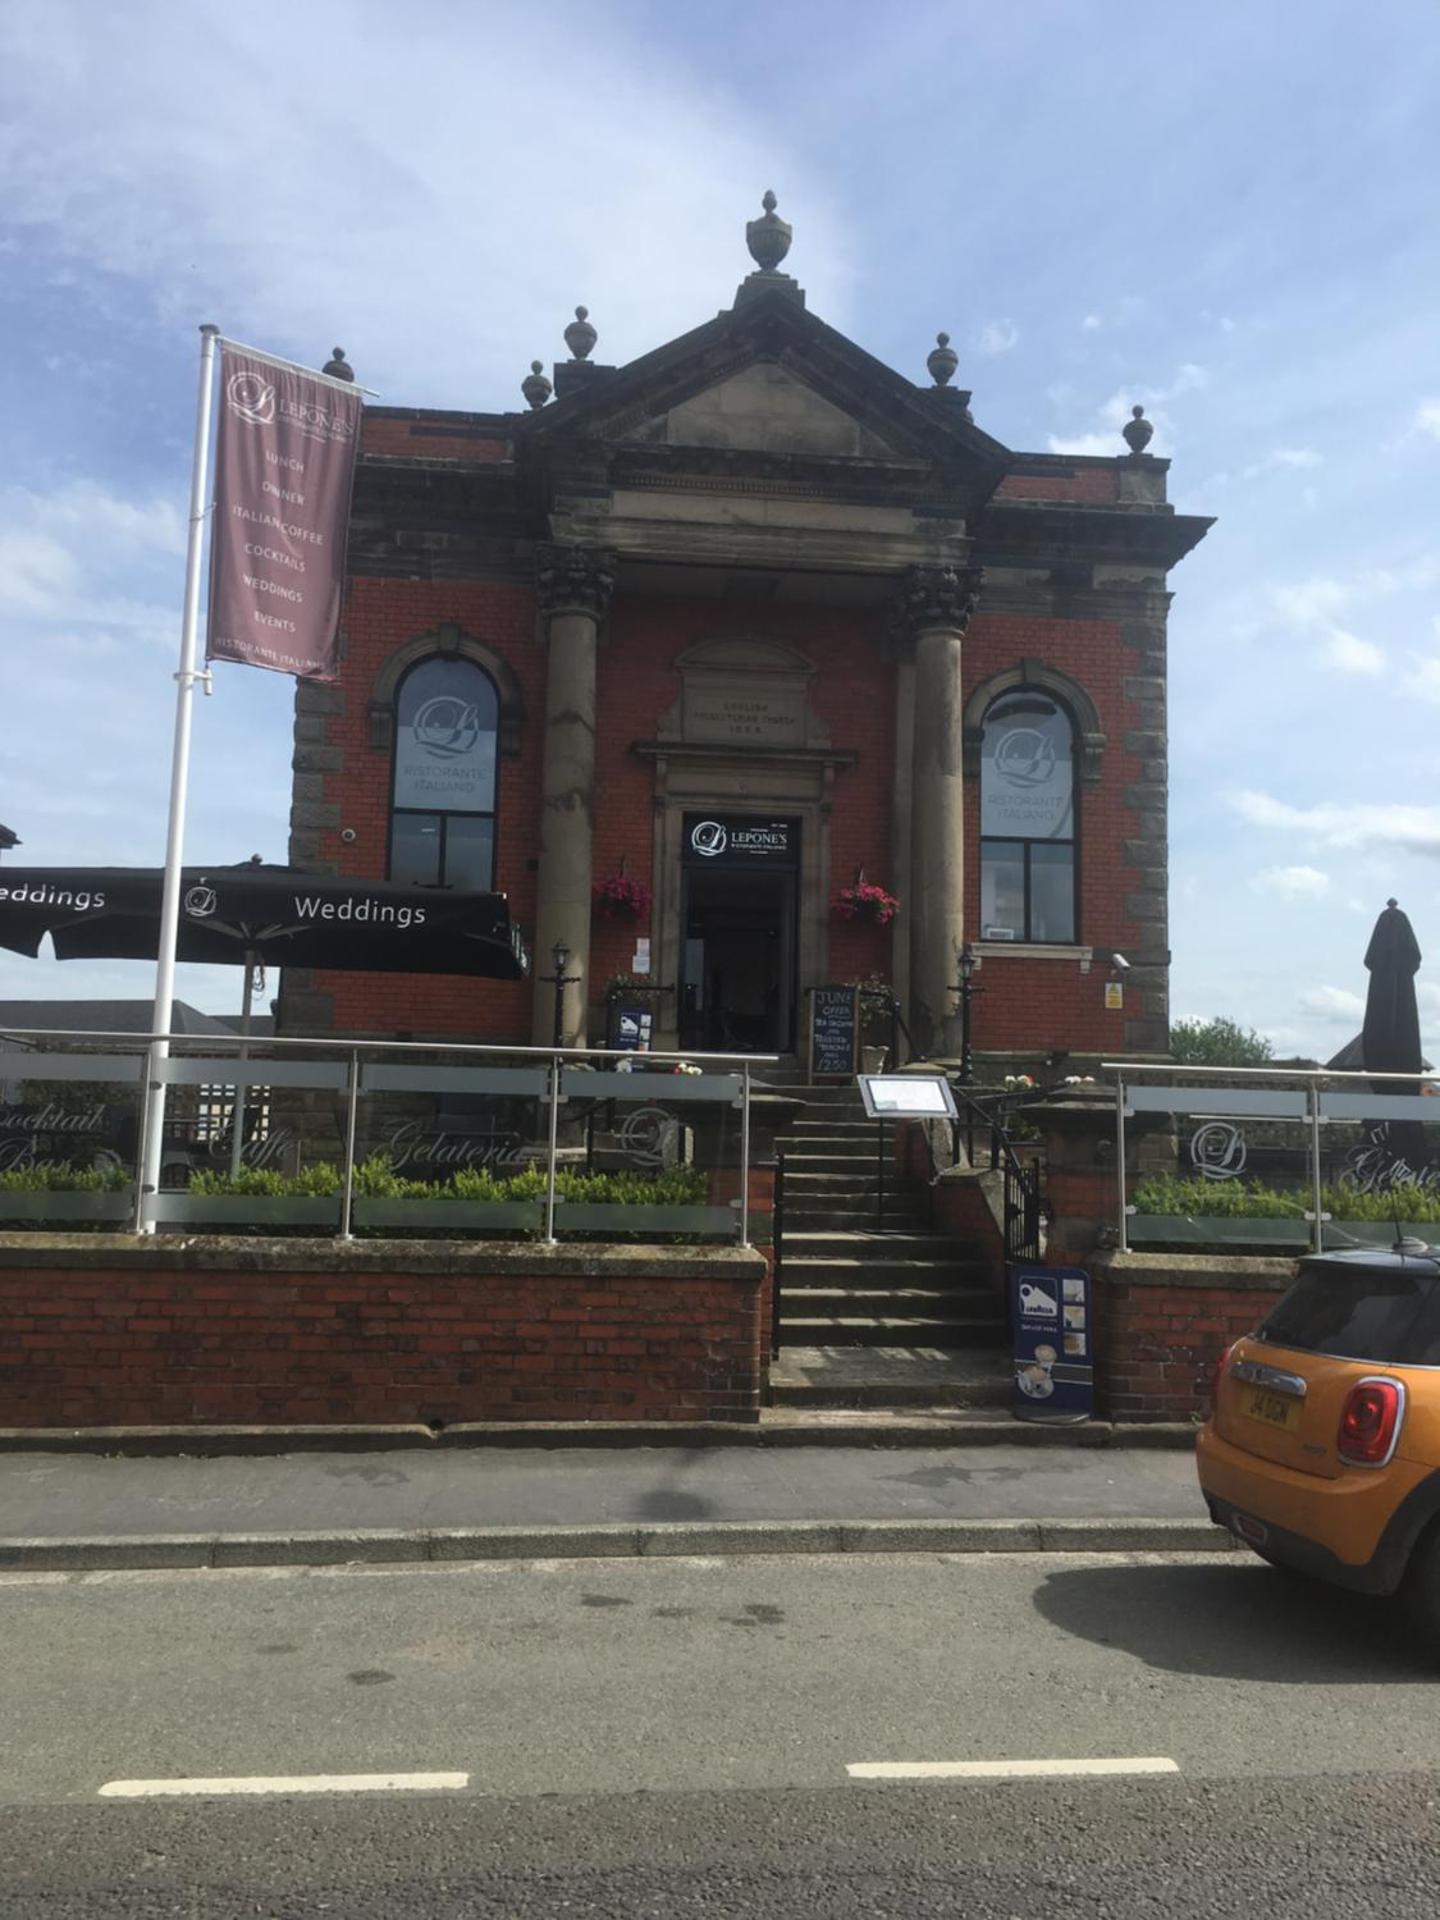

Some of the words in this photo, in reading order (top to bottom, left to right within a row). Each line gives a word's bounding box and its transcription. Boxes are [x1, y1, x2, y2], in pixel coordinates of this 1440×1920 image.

[264, 449, 304, 475] LUNCH
[232, 504, 282, 530] ITALIAN
[280, 521, 324, 546] COFFEE
[243, 542, 305, 573] COCKTAILS
[242, 573, 304, 603] WEDDINGS
[253, 609, 297, 634] EVENTS
[0, 886, 106, 912] eddings
[294, 896, 426, 929] Weddings
[372, 1117, 526, 1170] Gelateria
